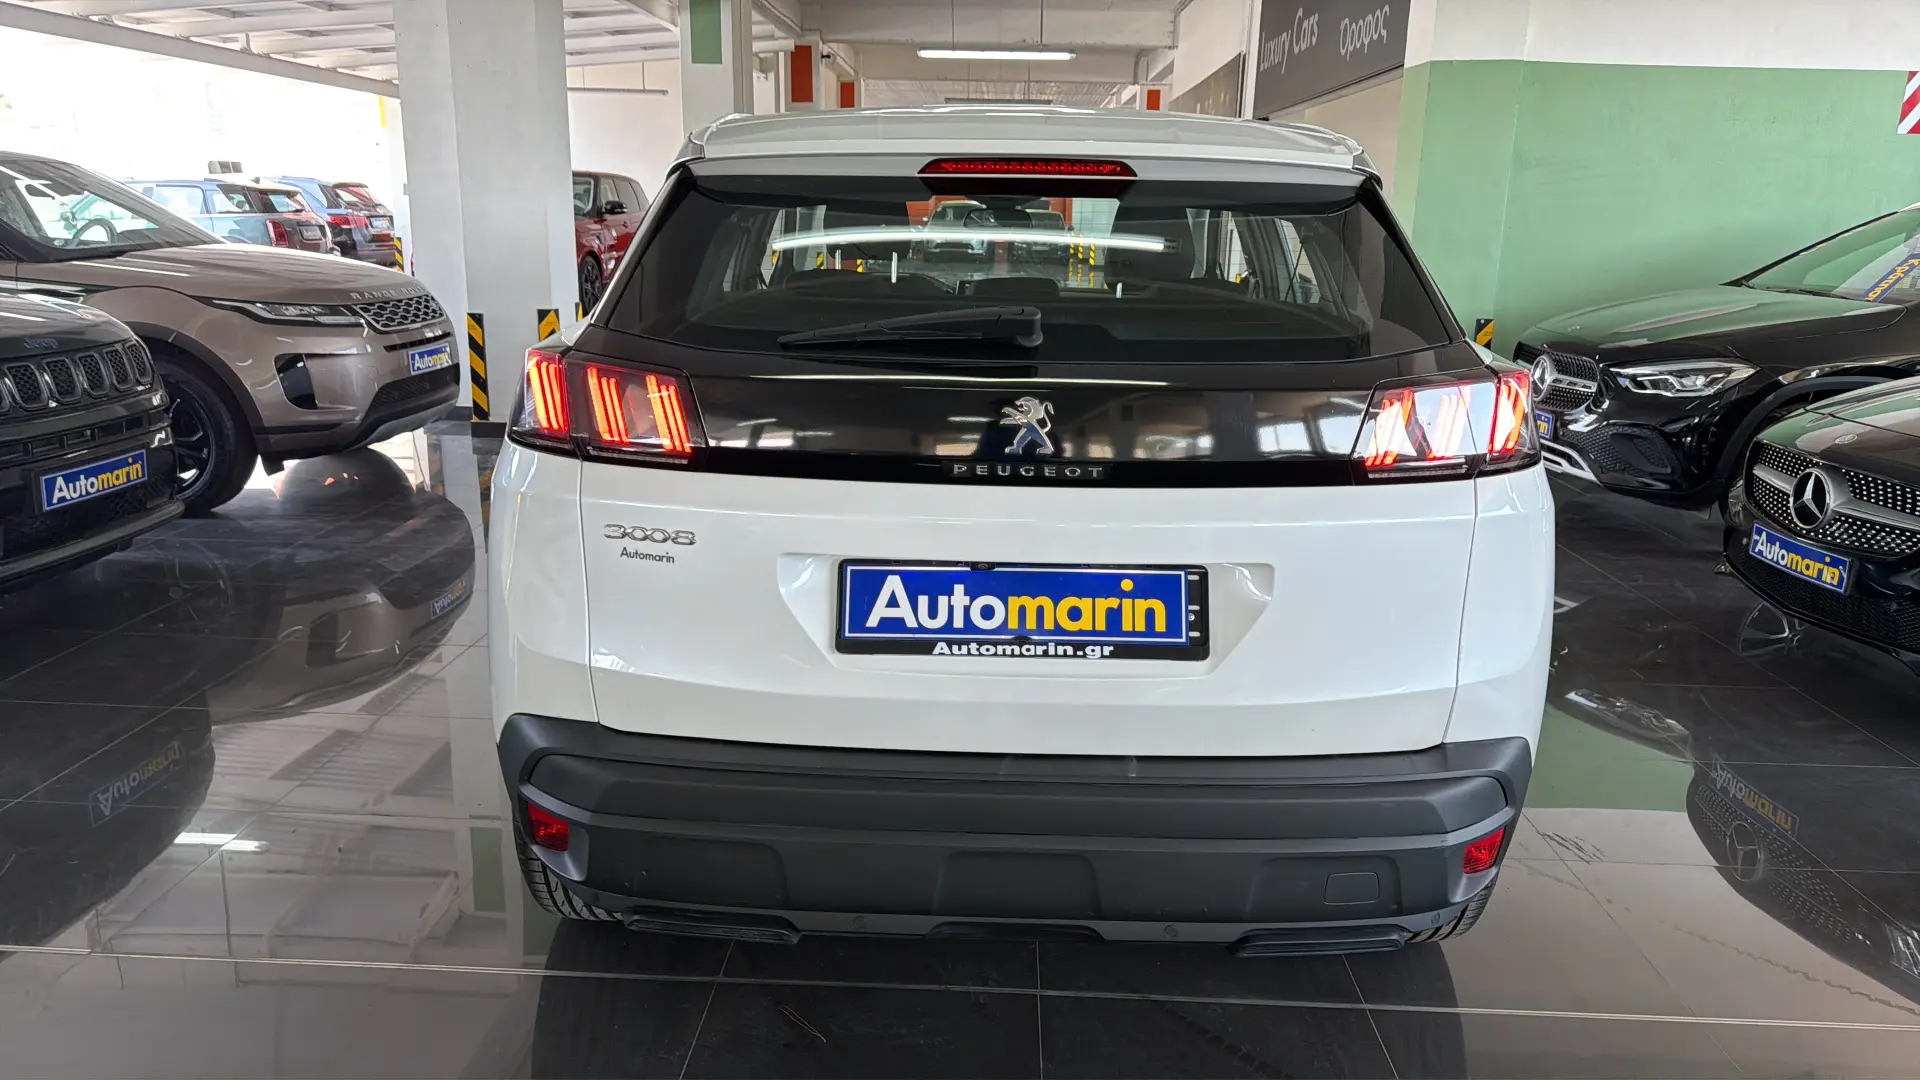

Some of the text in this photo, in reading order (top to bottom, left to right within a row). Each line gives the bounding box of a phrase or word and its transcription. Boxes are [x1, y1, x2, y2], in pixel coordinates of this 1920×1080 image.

[1260, 7, 1319, 74] Luxury Cars
[350, 290, 397, 300] RANGE
[52, 457, 142, 504] Automarin
[953, 464, 1102, 478] PEUGEOT
[604, 524, 697, 545] 3008
[620, 546, 675, 563] Automarin
[1754, 531, 1840, 586] Automarin
[865, 574, 1166, 632] Automarin
[932, 641, 1114, 659] Automarin.gr
